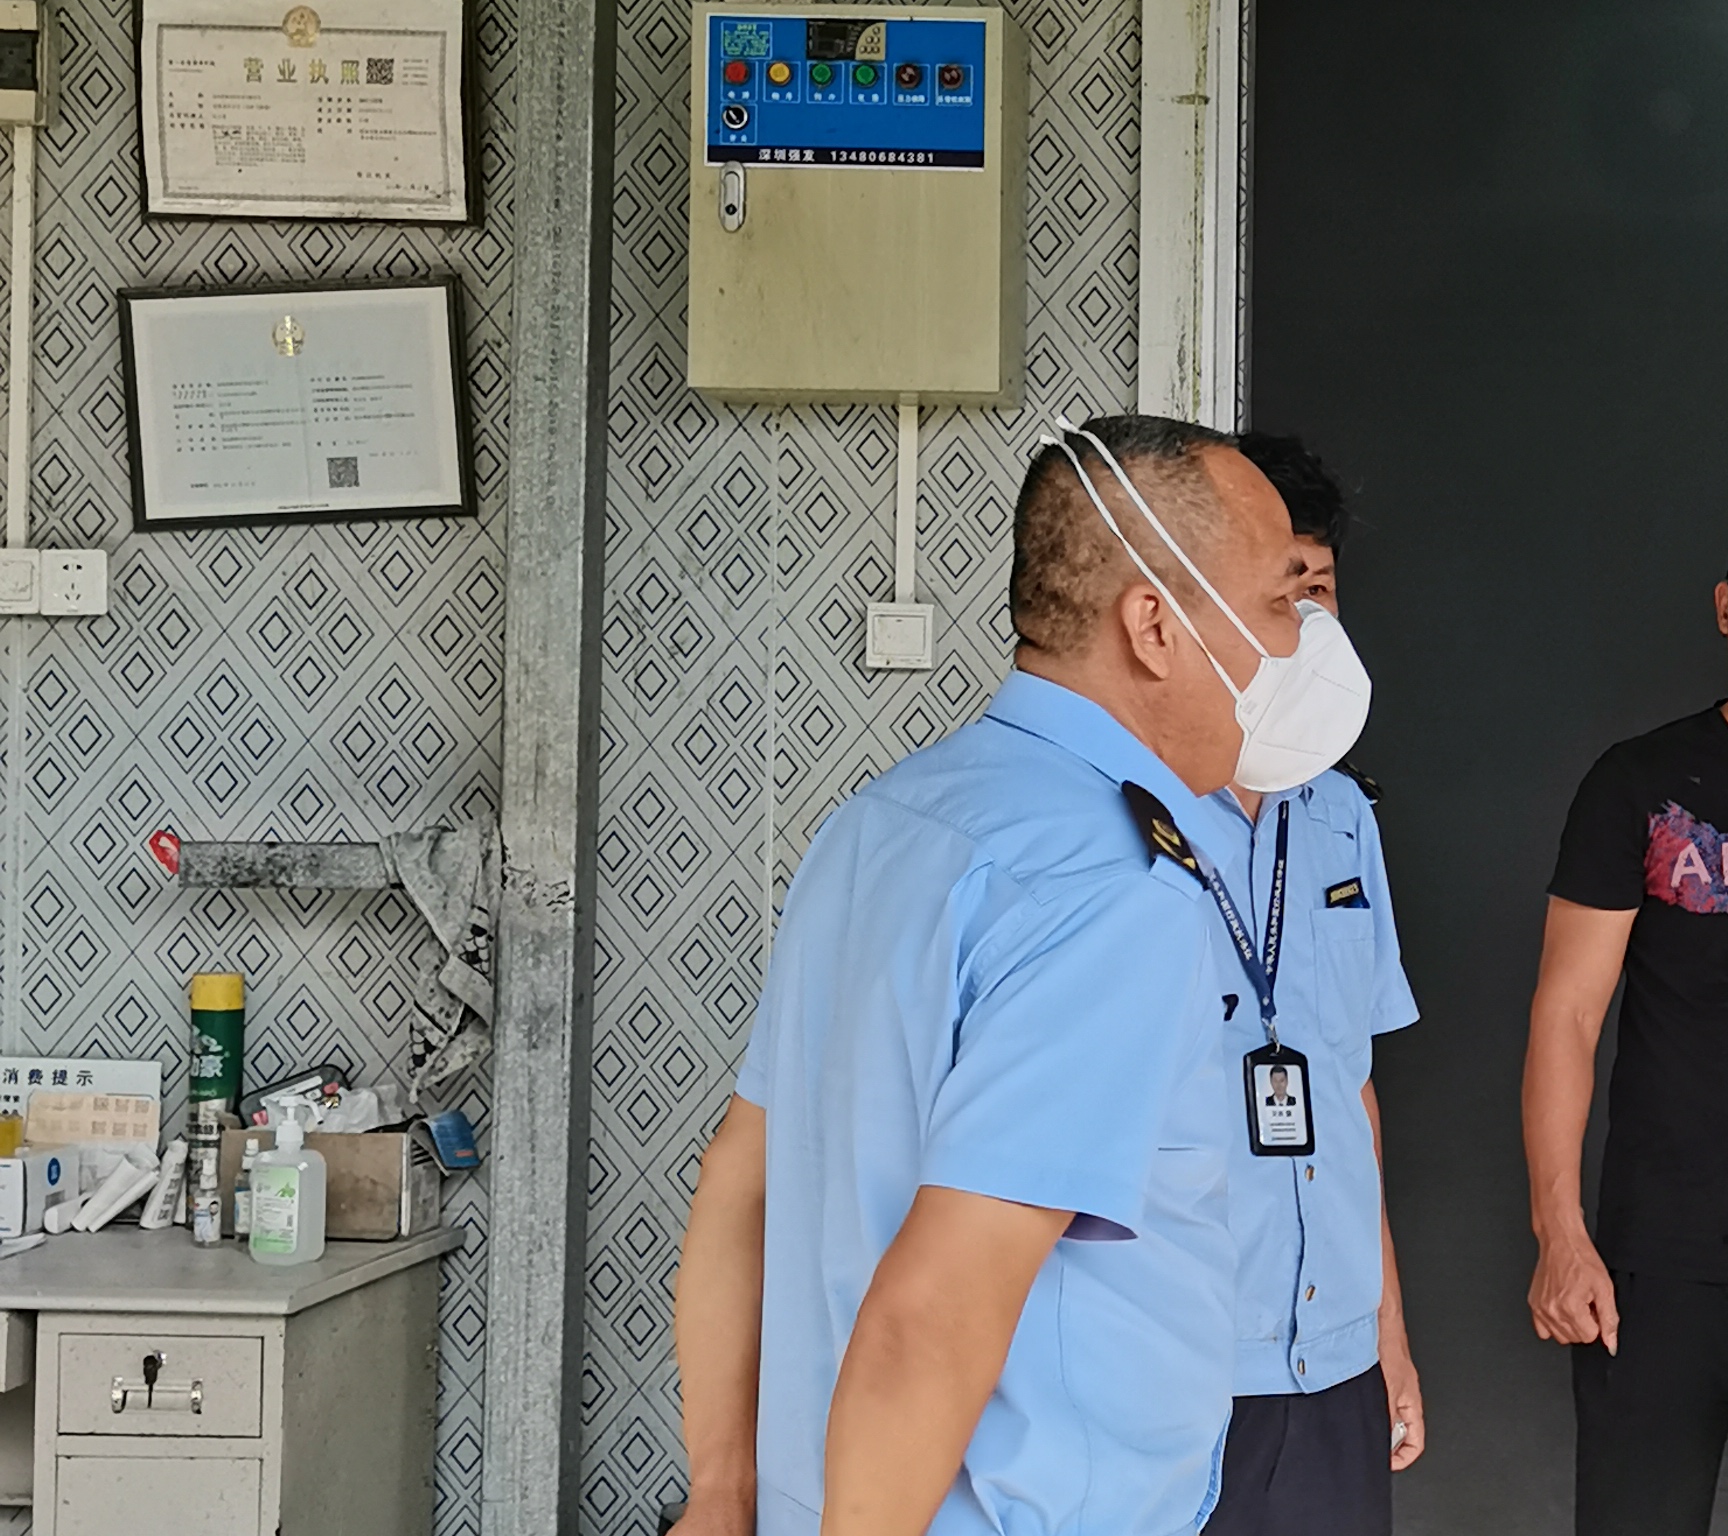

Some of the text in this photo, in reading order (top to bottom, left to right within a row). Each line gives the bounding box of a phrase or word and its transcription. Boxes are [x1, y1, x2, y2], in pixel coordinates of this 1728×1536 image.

[243, 56, 360, 85] 营业执照
[758, 148, 935, 164] 深圳强发 13480684381
[2, 1067, 94, 1087] 消费提示
